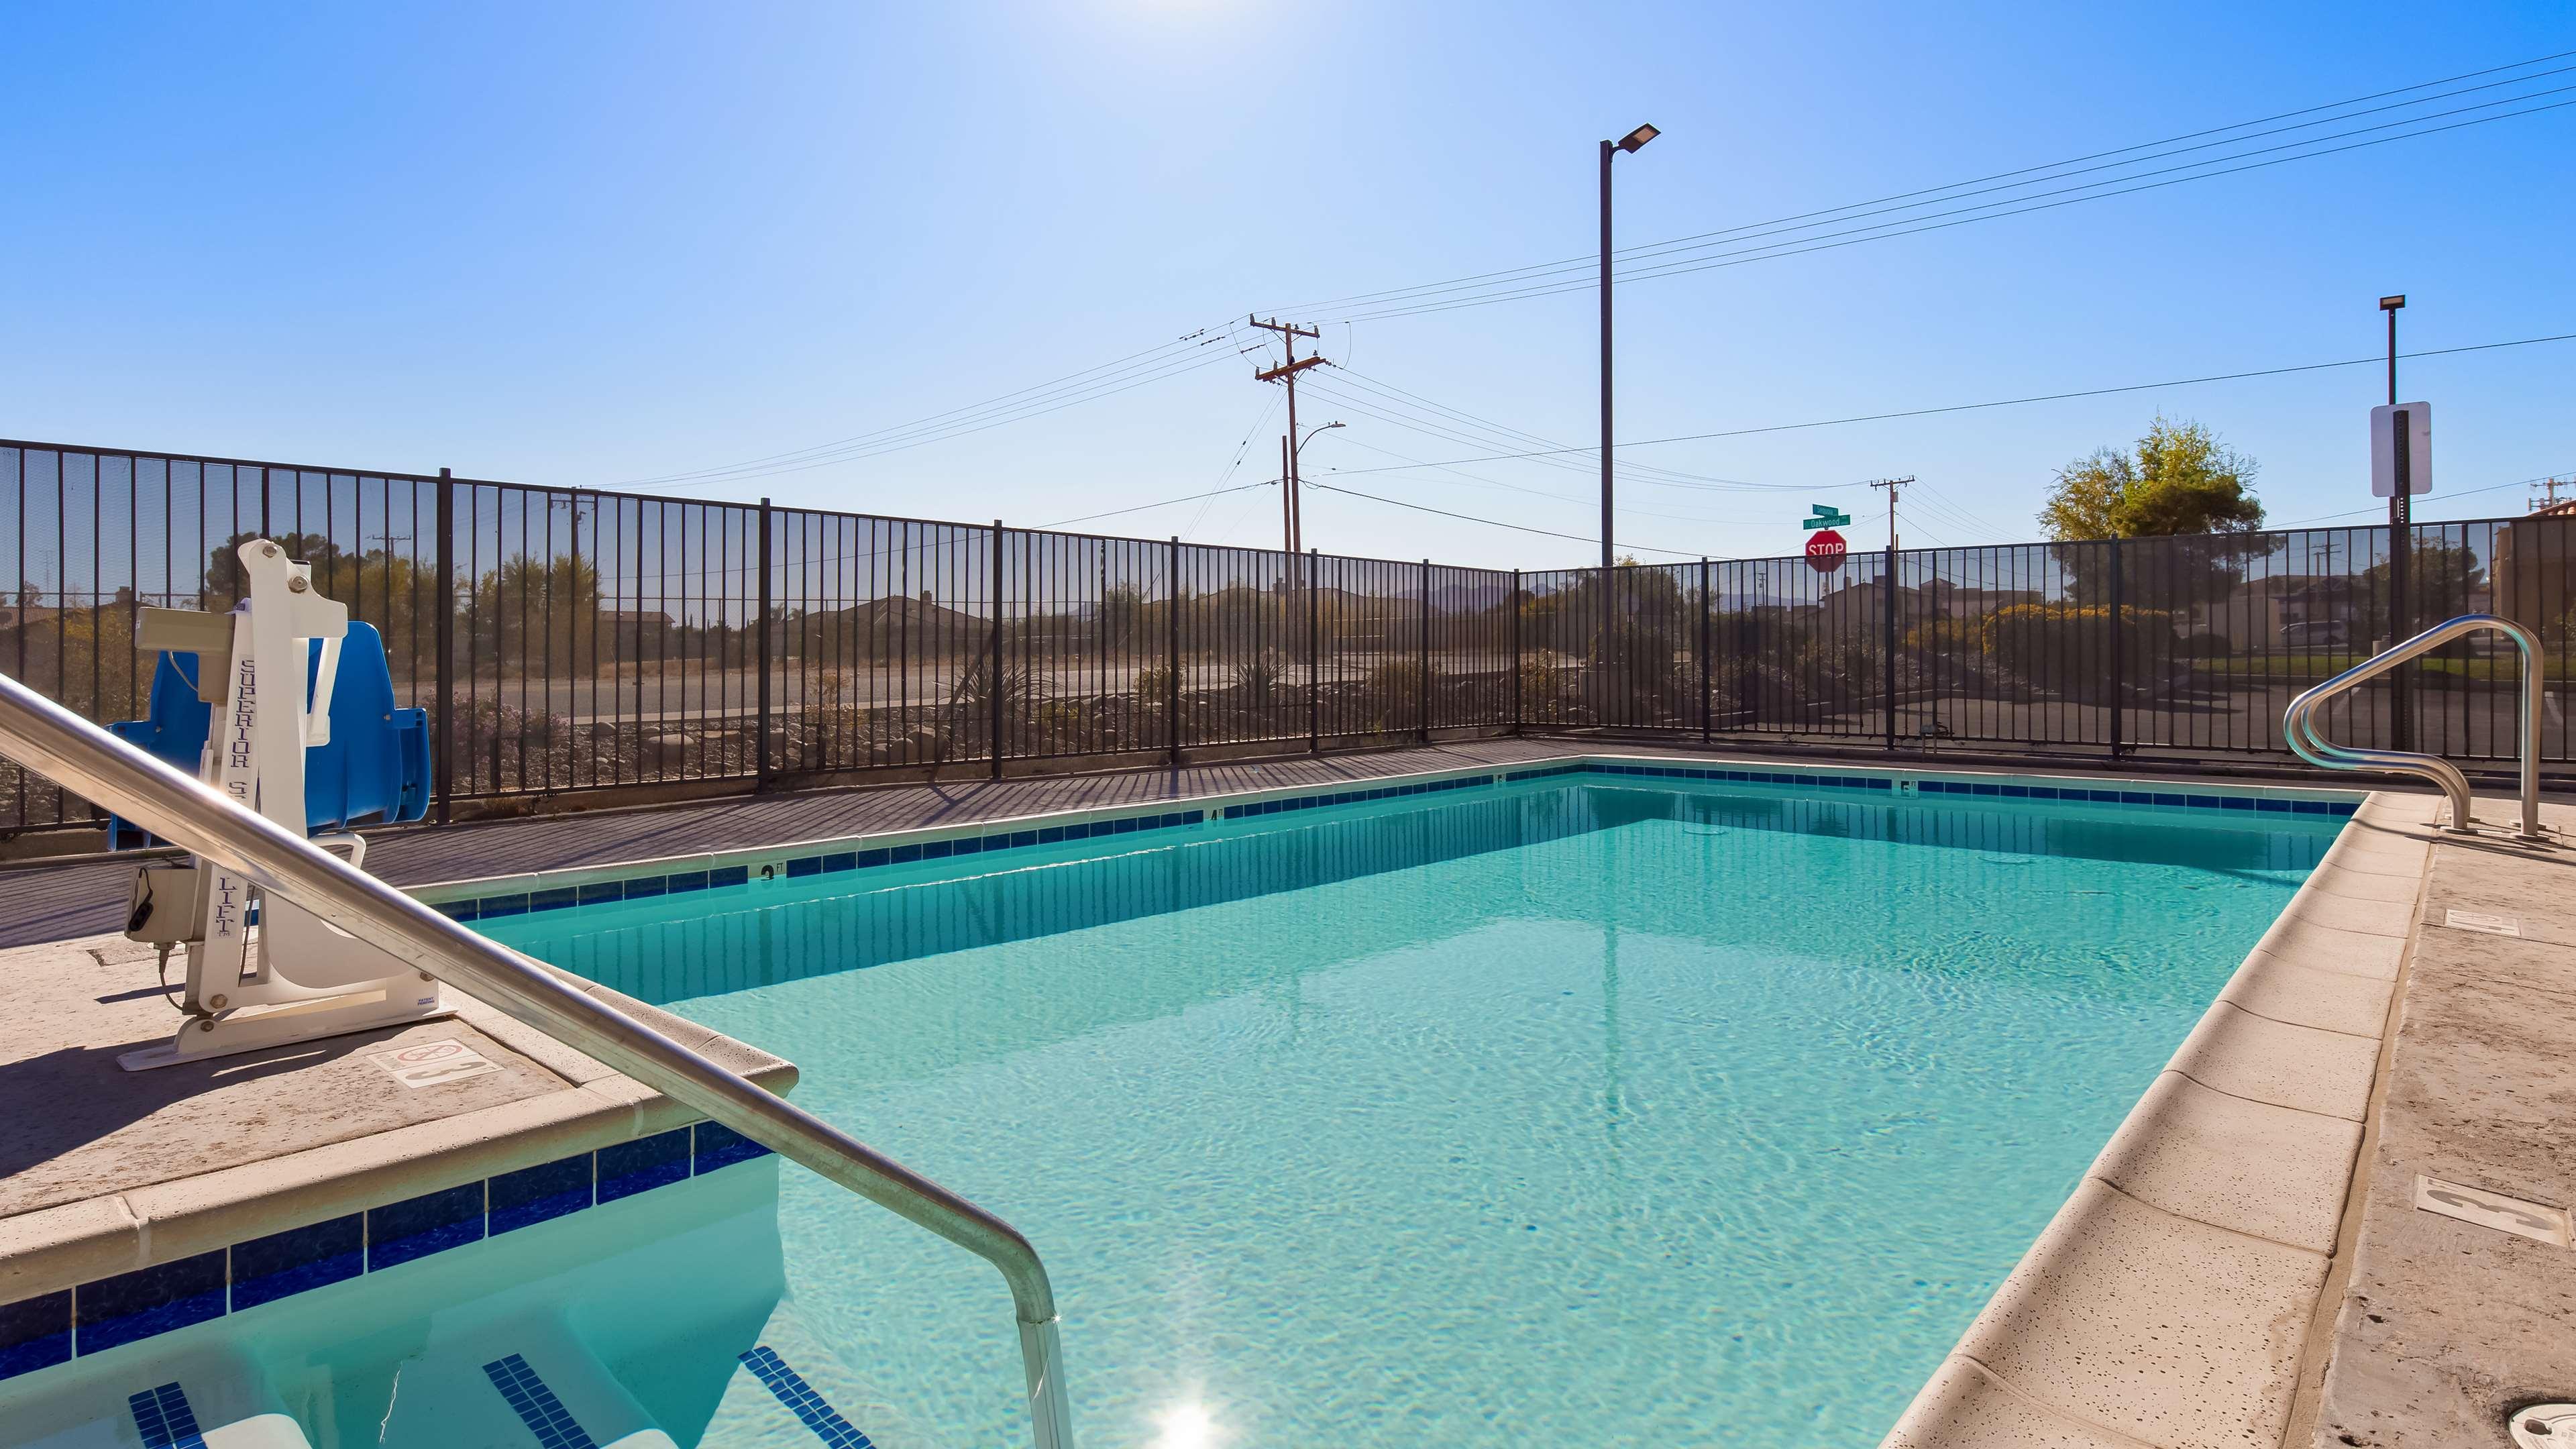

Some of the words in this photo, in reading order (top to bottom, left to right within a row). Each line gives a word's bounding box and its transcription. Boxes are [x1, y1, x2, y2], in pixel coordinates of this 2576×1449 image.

[1811, 517, 1840, 527] Oakwood
[1809, 543, 1844, 558] STOP
[230, 659, 256, 768] SUPERIOR
[776, 863, 784, 873] FT
[215, 877, 237, 932] LIFT
[2426, 1189, 2557, 1230] 3
